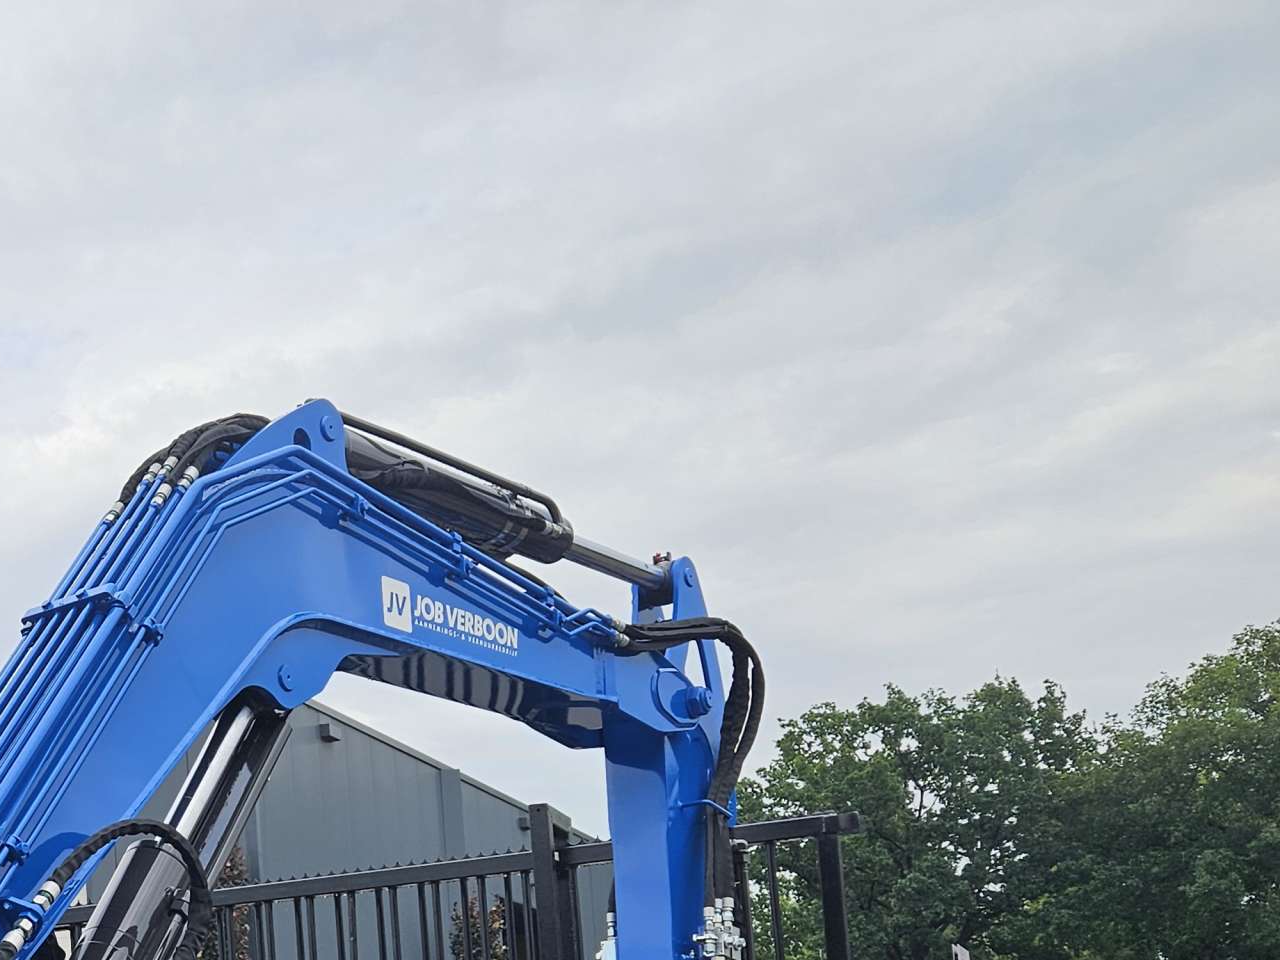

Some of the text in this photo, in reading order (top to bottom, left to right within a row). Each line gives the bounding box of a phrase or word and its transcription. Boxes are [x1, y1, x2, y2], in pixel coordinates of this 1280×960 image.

[387, 592, 406, 616] JV
[414, 594, 518, 649] JOB VERBOON
